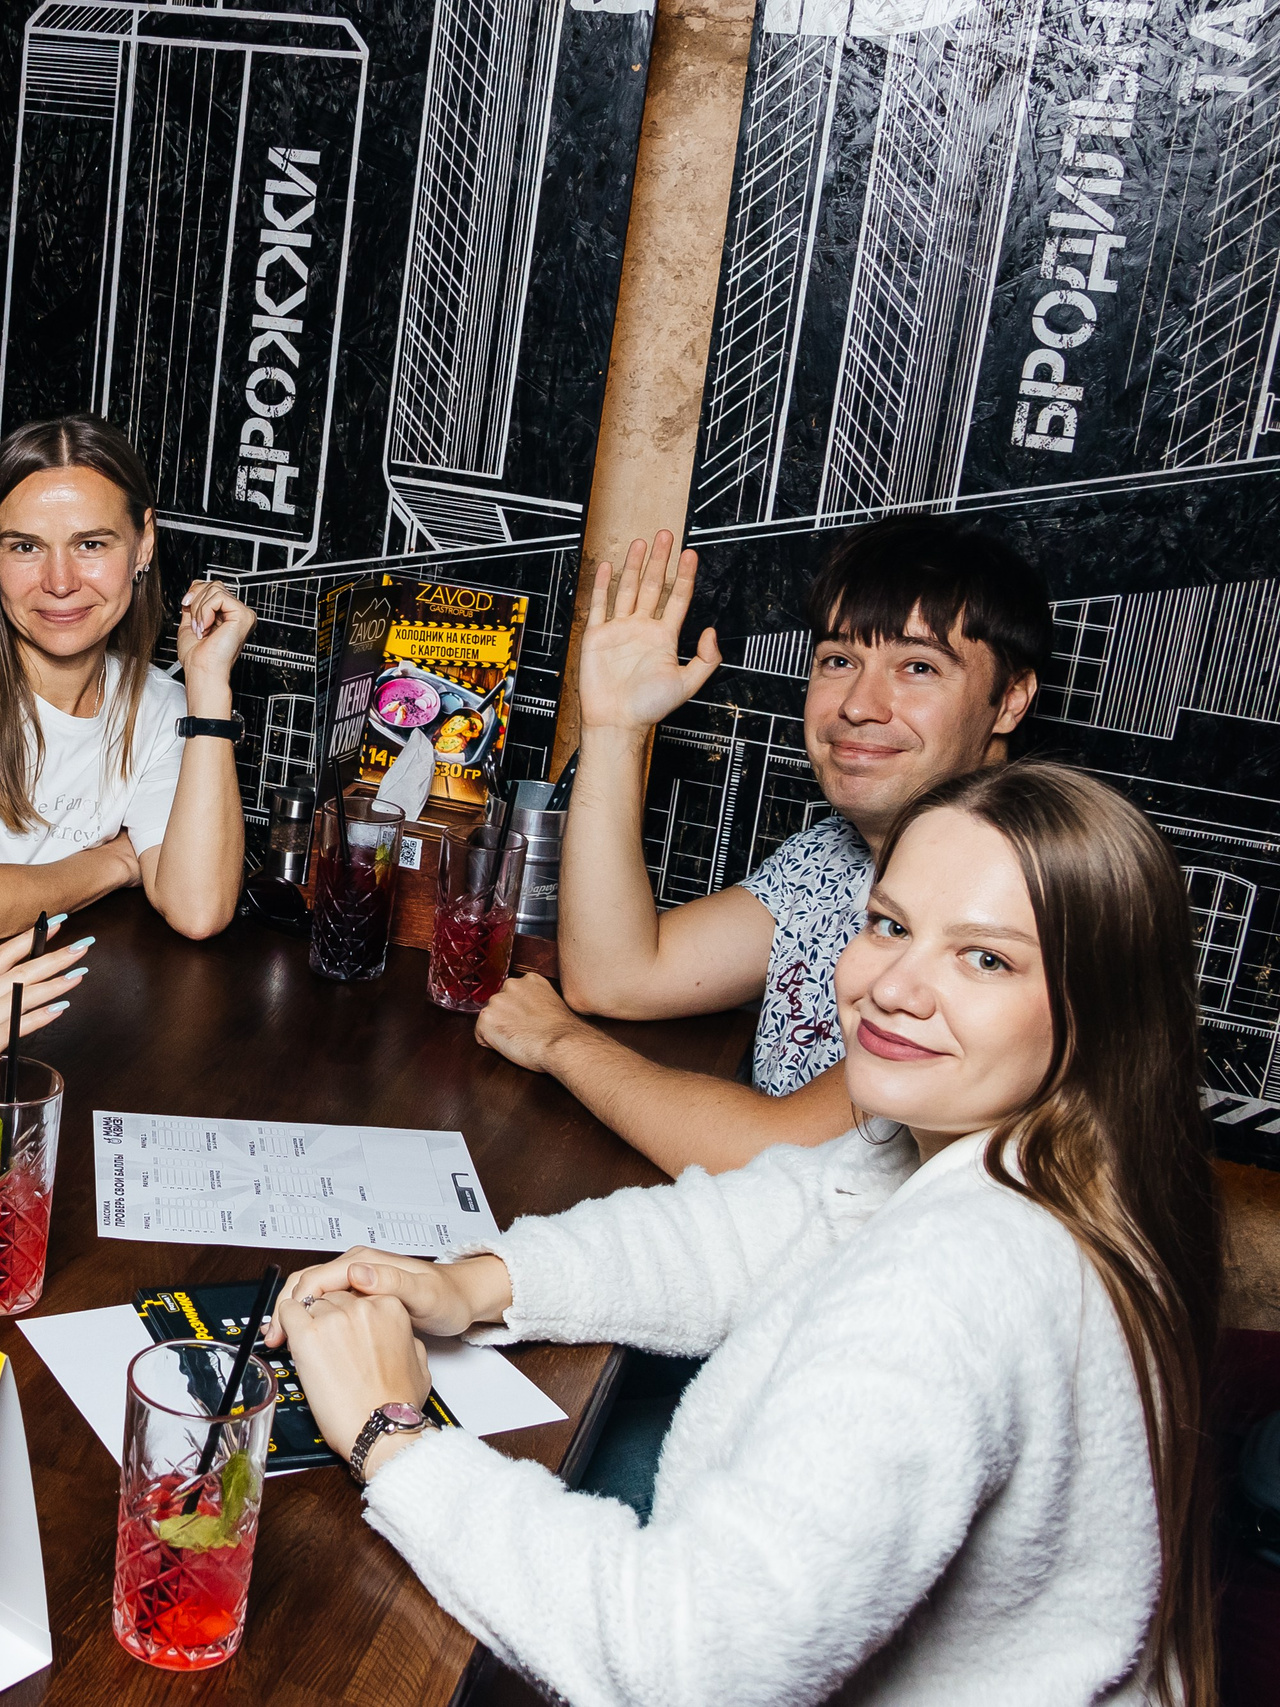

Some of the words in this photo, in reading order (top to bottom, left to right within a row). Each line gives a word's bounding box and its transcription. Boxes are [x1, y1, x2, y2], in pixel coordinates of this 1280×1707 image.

[235, 146, 321, 516] ДРОЖЖИ
[415, 582, 493, 611] ZAVOD
[429, 604, 474, 618] GASTROPUB
[349, 618, 387, 645] ZAVOD
[395, 628, 443, 644] ХОЛОДНИК
[446, 632, 458, 644] НА
[460, 633, 497, 647] КЕФИРЕ
[410, 644, 416, 655] С
[418, 644, 479, 660] КАРТОФЕЛЕМ
[335, 677, 372, 720] МЕНЮ
[328, 713, 366, 759] КУХНИ
[368, 747, 388, 767] 14
[463, 768, 482, 780] ГР
[102, 1116, 113, 1136] МАМА
[113, 1117, 124, 1138] КВИЗ!
[113, 1153, 125, 1177] БАЛЛЫ
[103, 1200, 111, 1226] КЛАССИКА
[114, 1197, 125, 1228] ПРОВЕРЬ
[173, 1291, 214, 1340] Разминка
